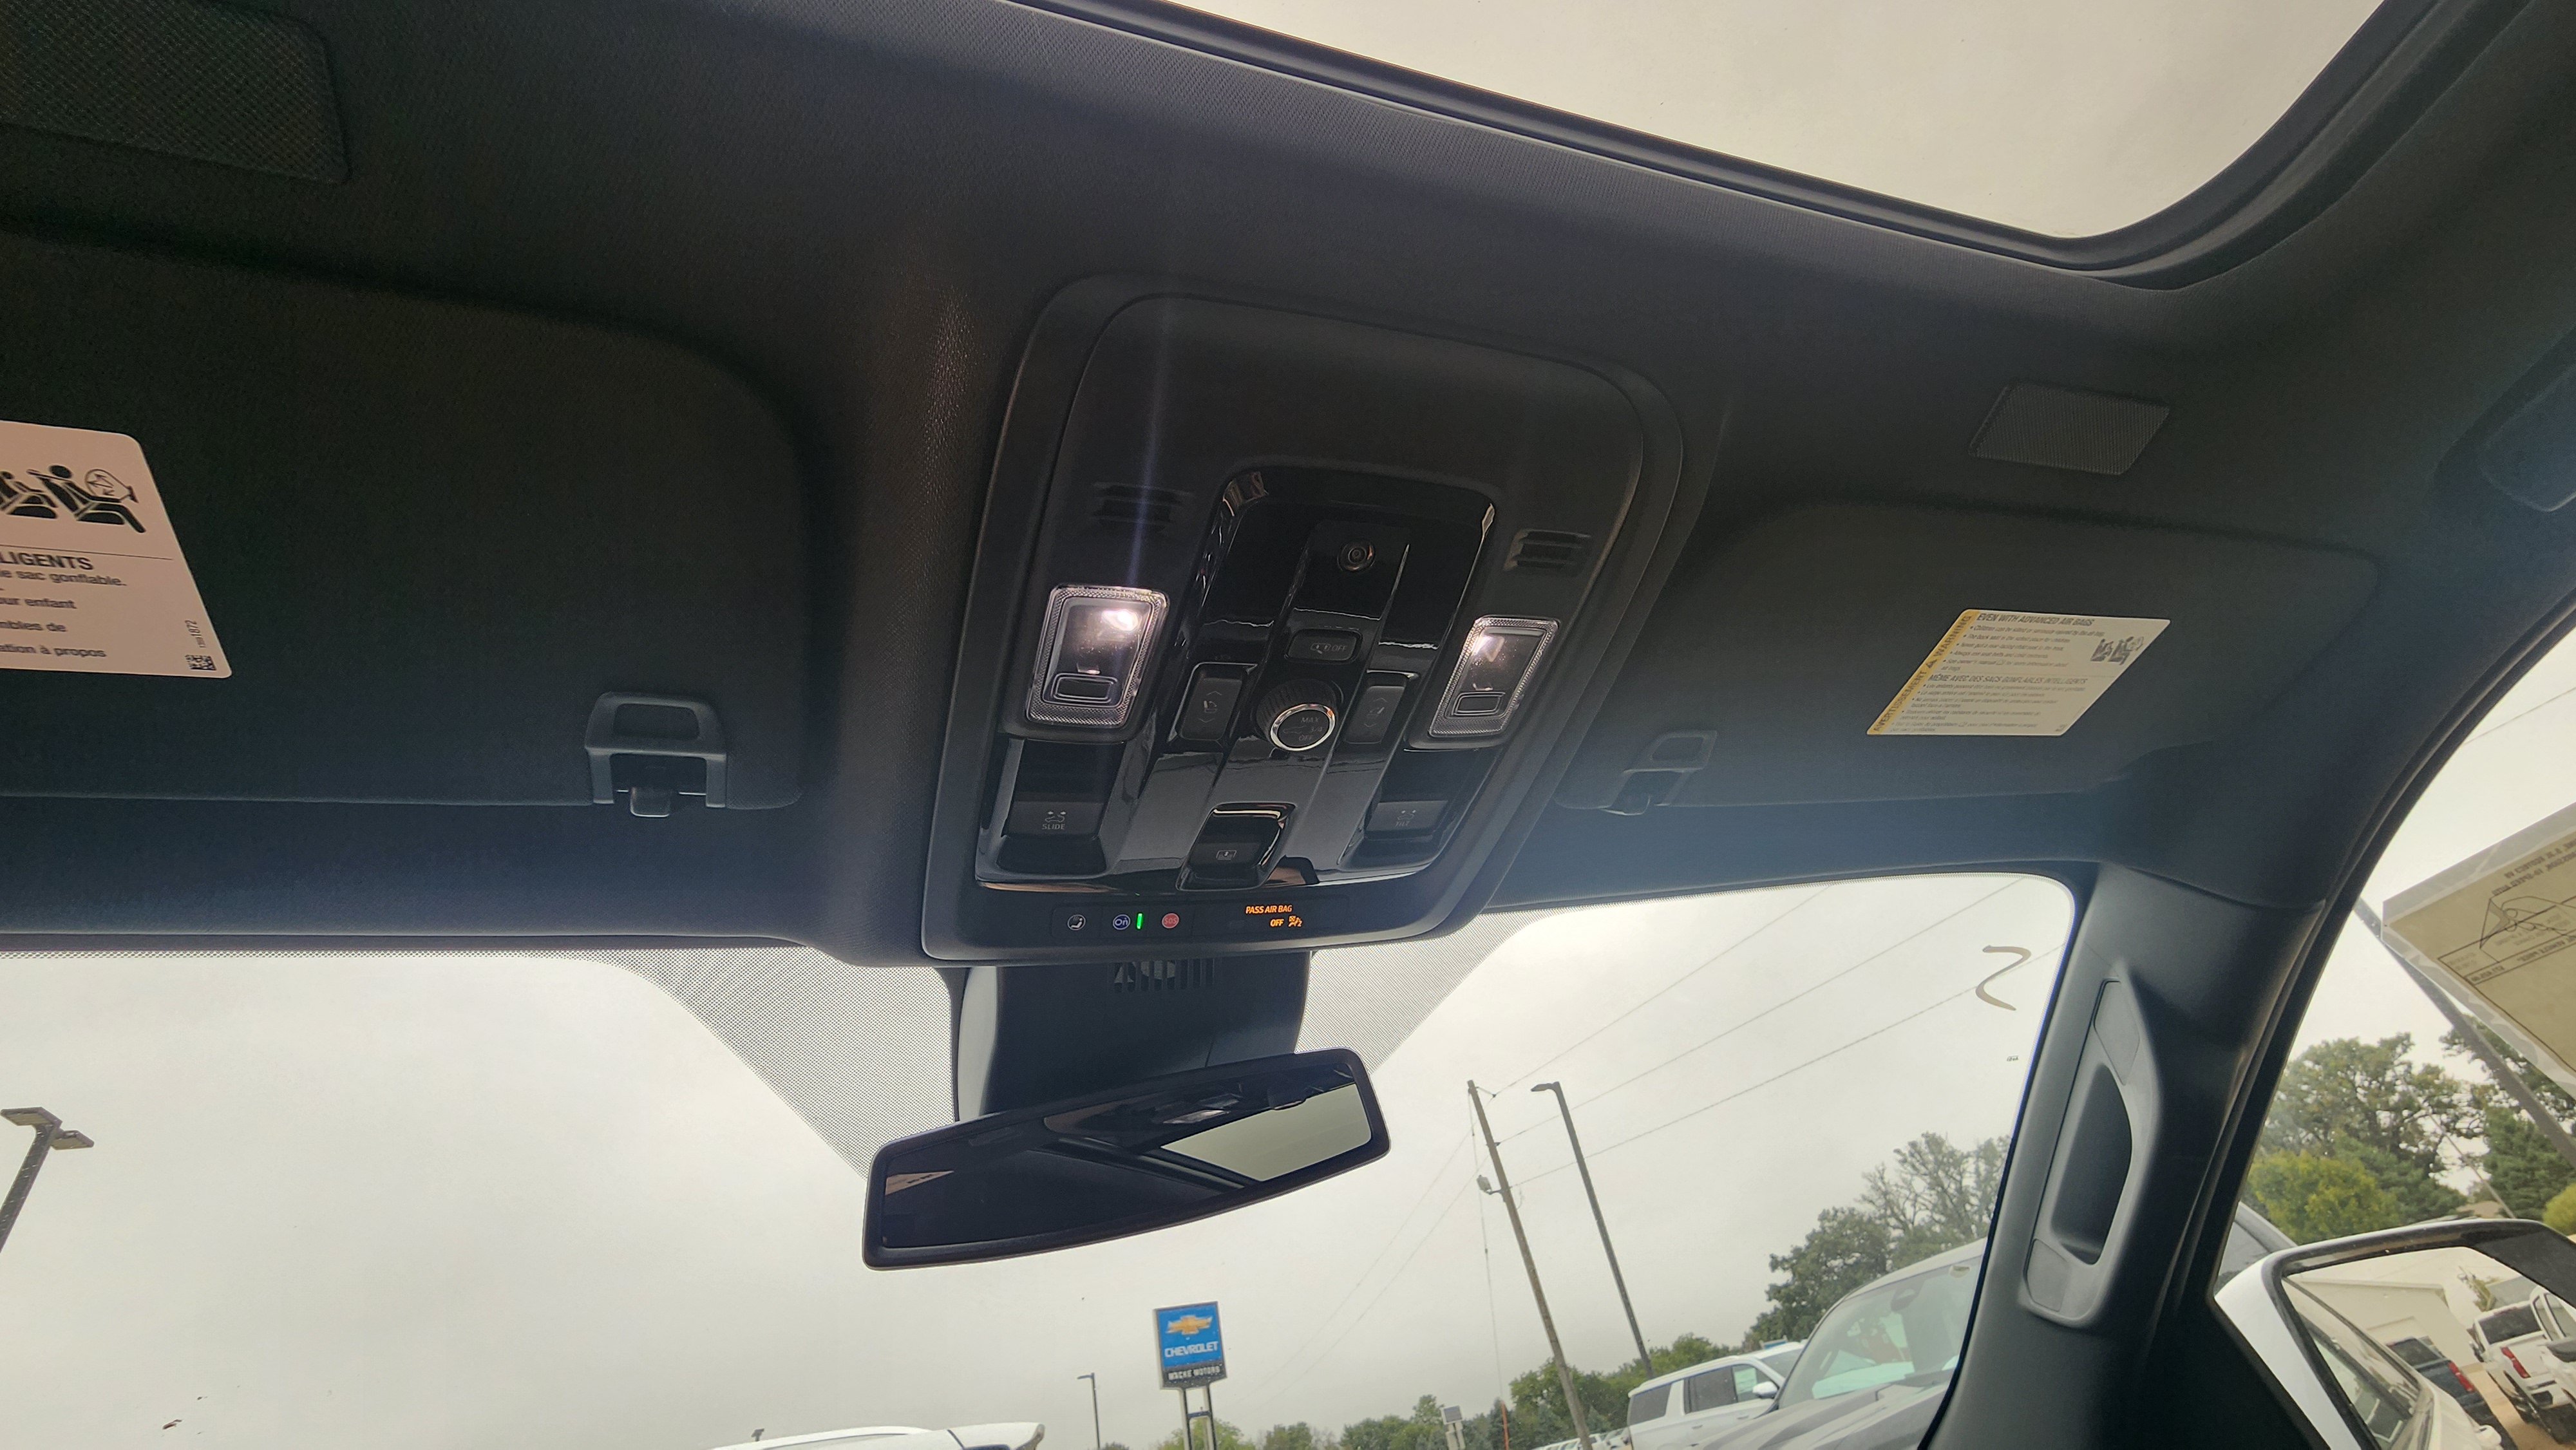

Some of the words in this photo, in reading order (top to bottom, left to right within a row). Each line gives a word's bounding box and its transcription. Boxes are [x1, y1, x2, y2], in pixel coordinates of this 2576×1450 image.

[16, 571, 47, 581] sac
[24, 597, 77, 610] enfant
[1976, 613, 2000, 621] EVEN
[2016, 616, 2061, 624] ADVANCED
[46, 621, 66, 632] de
[1933, 615, 1971, 660] WARNING
[54, 646, 108, 659] propos
[1873, 670, 1927, 732] AVERTISSEMENT
[1164, 1341, 1218, 1357] CHEVROLET
[1193, 1366, 1220, 1376] MOTORS
